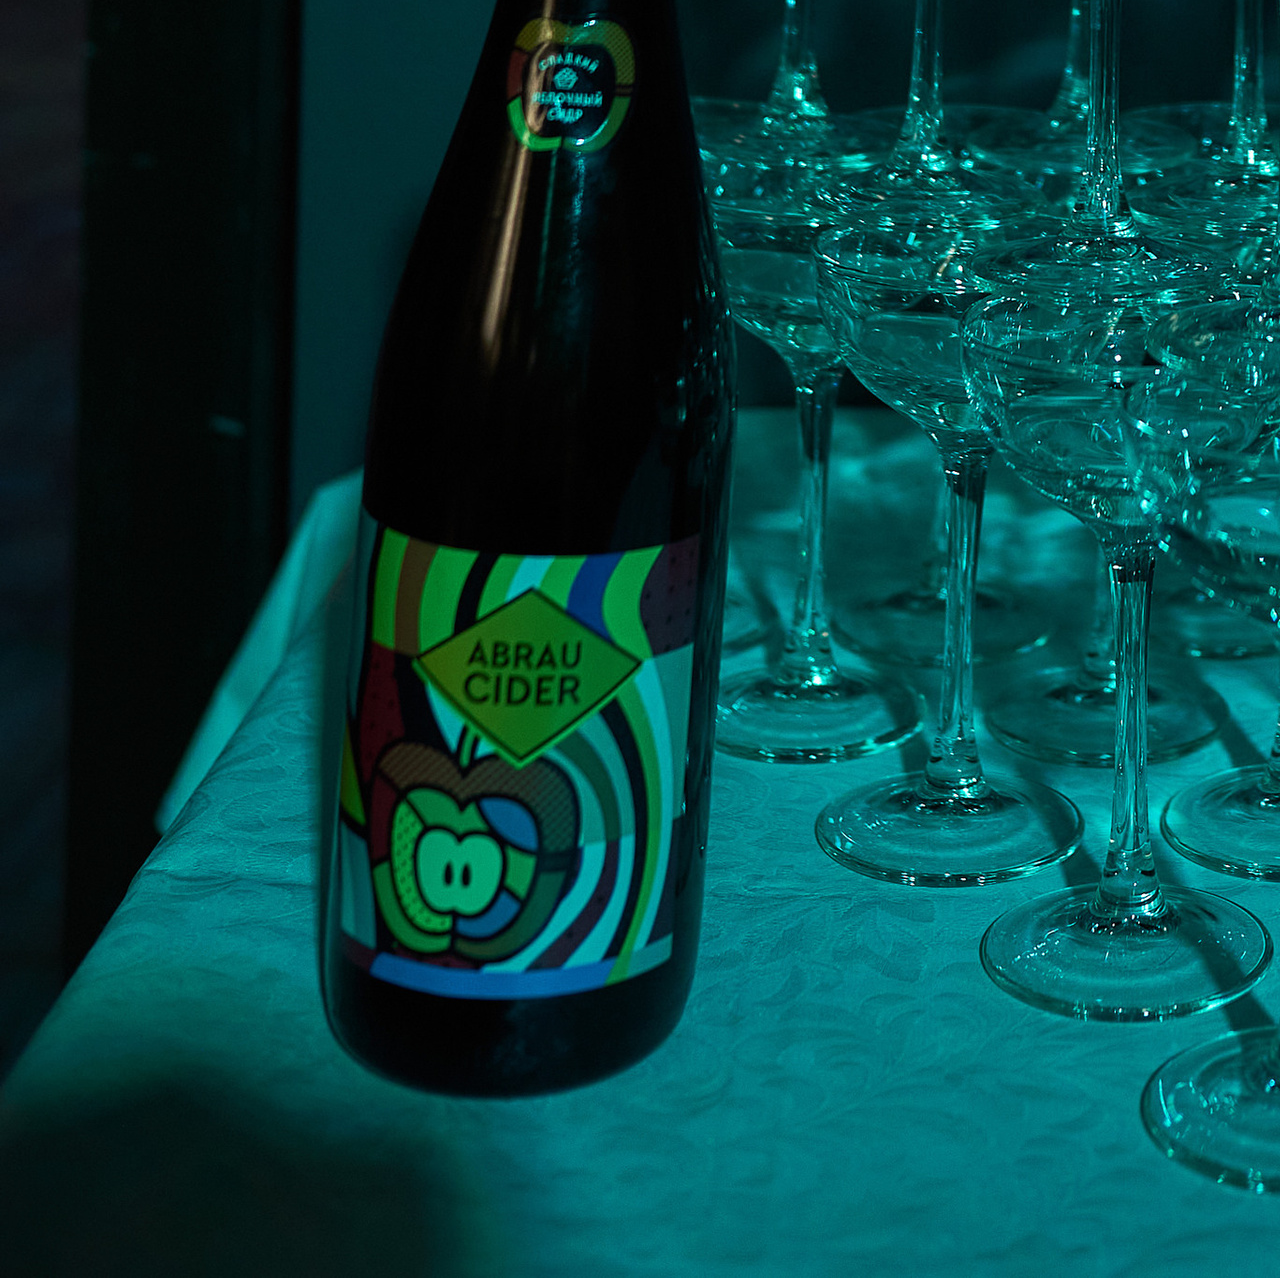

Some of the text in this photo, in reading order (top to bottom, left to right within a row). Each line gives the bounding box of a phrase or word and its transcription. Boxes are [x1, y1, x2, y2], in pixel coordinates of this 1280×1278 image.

[546, 107, 584, 123] СИДР
[467, 638, 582, 670] ABRAU
[463, 671, 581, 707] CIDER
